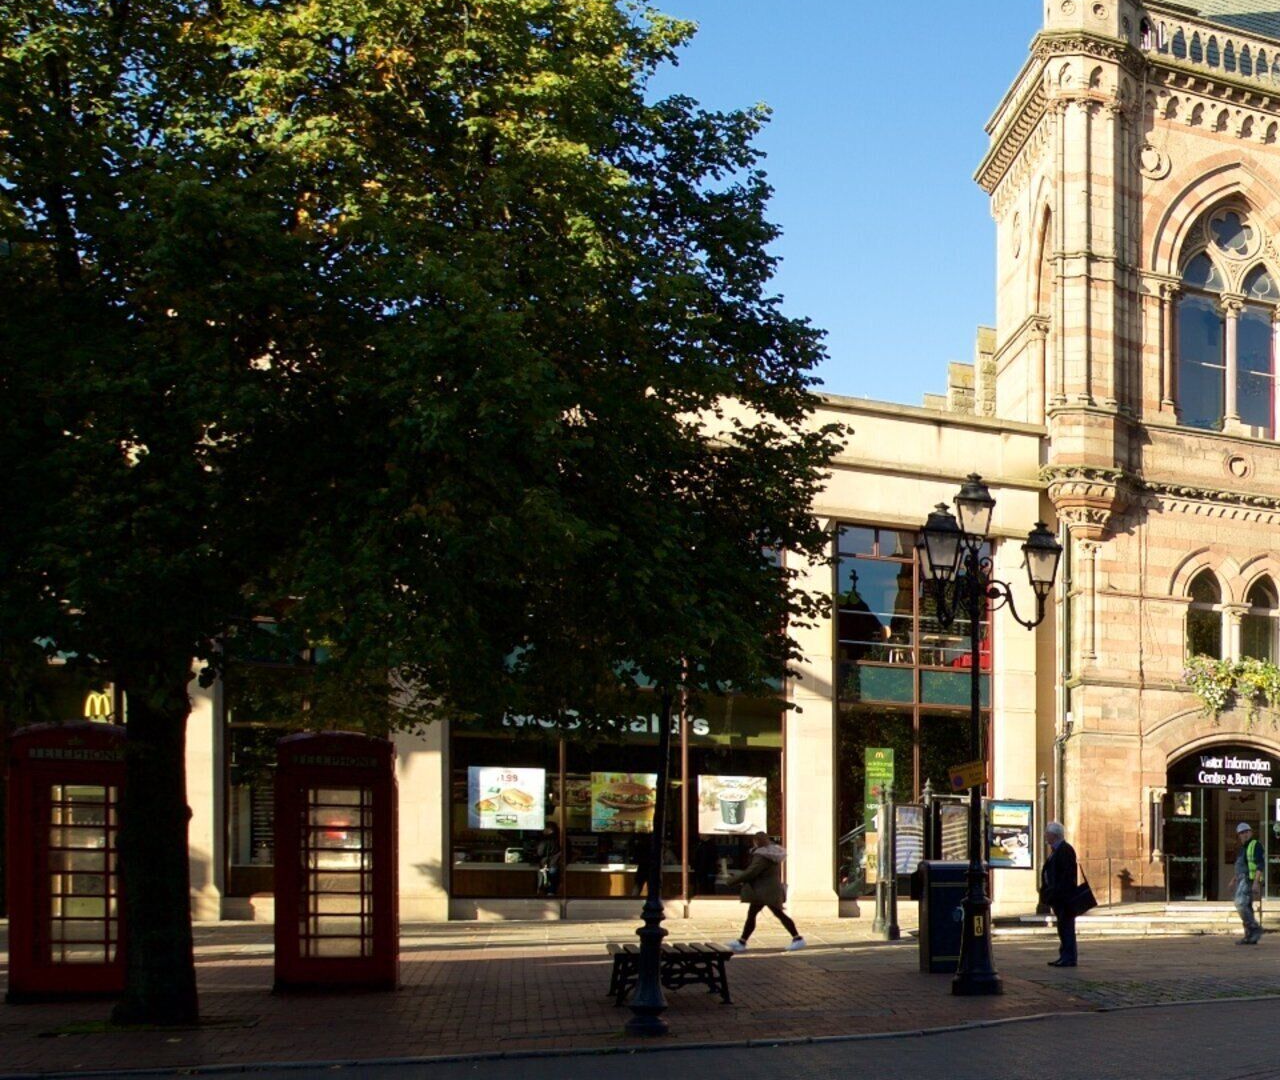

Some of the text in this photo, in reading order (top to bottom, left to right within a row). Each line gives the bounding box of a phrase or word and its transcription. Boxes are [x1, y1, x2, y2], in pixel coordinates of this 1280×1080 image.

[1200, 755, 1271, 771] Visitor Information
[1198, 771, 1273, 786] Centre & Box Office
